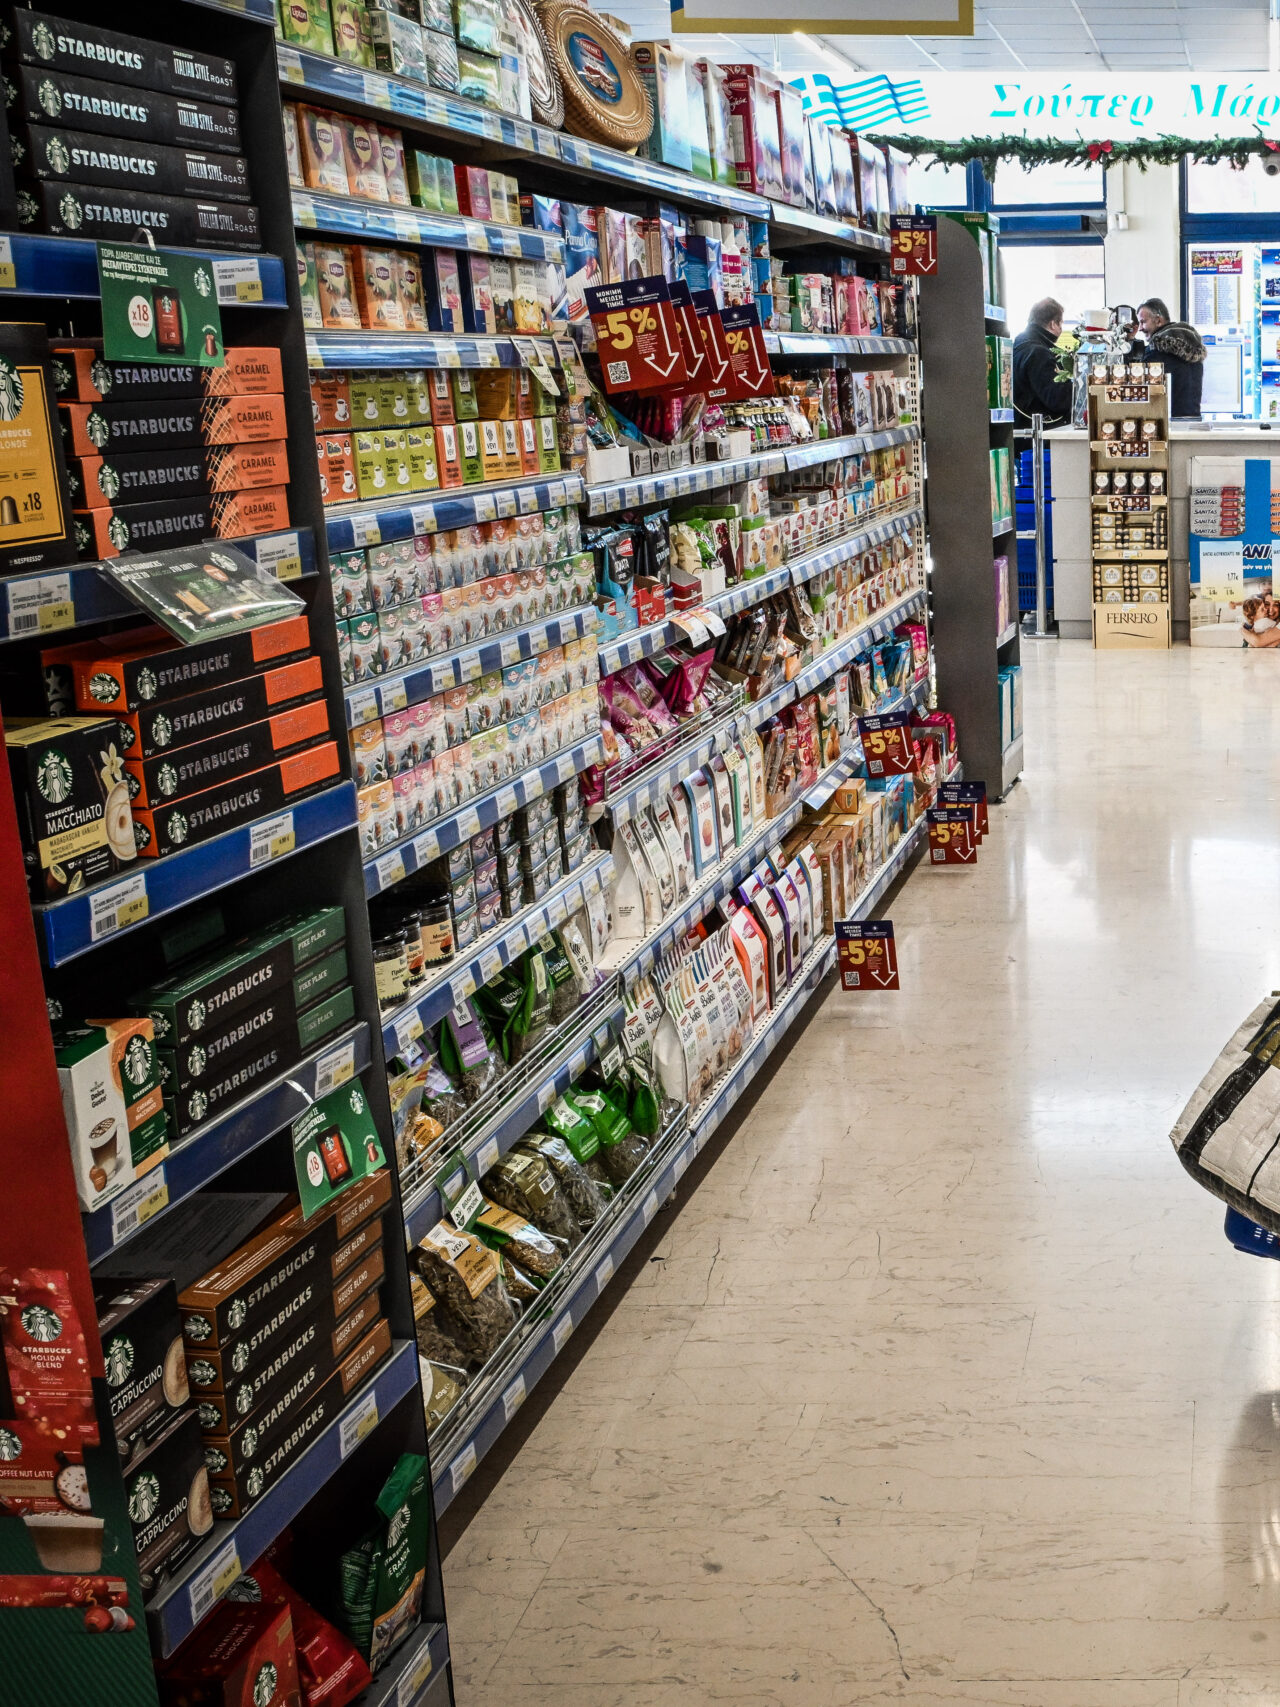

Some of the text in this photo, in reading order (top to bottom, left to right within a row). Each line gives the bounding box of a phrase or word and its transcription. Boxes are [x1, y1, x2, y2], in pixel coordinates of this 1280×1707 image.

[57, 35, 145, 70] STARBUCKS
[210, 75, 234, 88] ROAST
[63, 93, 149, 123] STARBUCKS
[988, 83, 1155, 127] Σούπερ
[71, 149, 157, 176] STARBUCKS
[85, 204, 170, 228] STARBUCKS
[892, 231, 927, 252] -5%
[132, 304, 150, 323] x18
[597, 307, 657, 350] -5%
[114, 367, 195, 384] STARBUCKS
[235, 365, 271, 375] CARAMEL
[111, 417, 195, 437] STARBUCKS
[236, 411, 274, 423] CARAMEL
[122, 466, 201, 488] STARBUCKS
[23, 492, 42, 511] x18
[1193, 498, 1218, 506] SANITAS
[1194, 487, 1219, 495] SANITAS
[131, 514, 206, 539] STARBUCKS
[13, 555, 43, 565] NESPRESSO
[1106, 612, 1158, 625] FERRERO
[159, 654, 231, 686] STARBUCKS
[173, 697, 246, 731] STARBUCKS
[864, 729, 900, 754] -5%
[179, 743, 251, 781] STARBUCKS
[47, 804, 102, 835] MACCHIATO
[189, 788, 262, 828] STARBUCKS
[930, 822, 965, 844] -5%
[841, 939, 883, 965] -5%
[207, 964, 274, 1013] STARBUCKS
[207, 1007, 275, 1059] STARBUCKS
[209, 1050, 279, 1103] STARBUCKS
[335, 1232, 366, 1265] HOUSE BLEND
[248, 1245, 317, 1308] STARBUCKS
[250, 1285, 314, 1351] STARBUCKS
[30, 1354, 66, 1363] HOLIDAY
[36, 1360, 62, 1370] BLEND
[254, 1324, 316, 1392] STARBUCKS
[111, 1364, 163, 1417] CAPPUCCINO
[258, 1368, 317, 1435] STARBUCKS
[264, 1406, 325, 1475] STARBUCKS
[34, 1470, 54, 1478] LATTE
[137, 1497, 188, 1553] CAPPUCCINO
